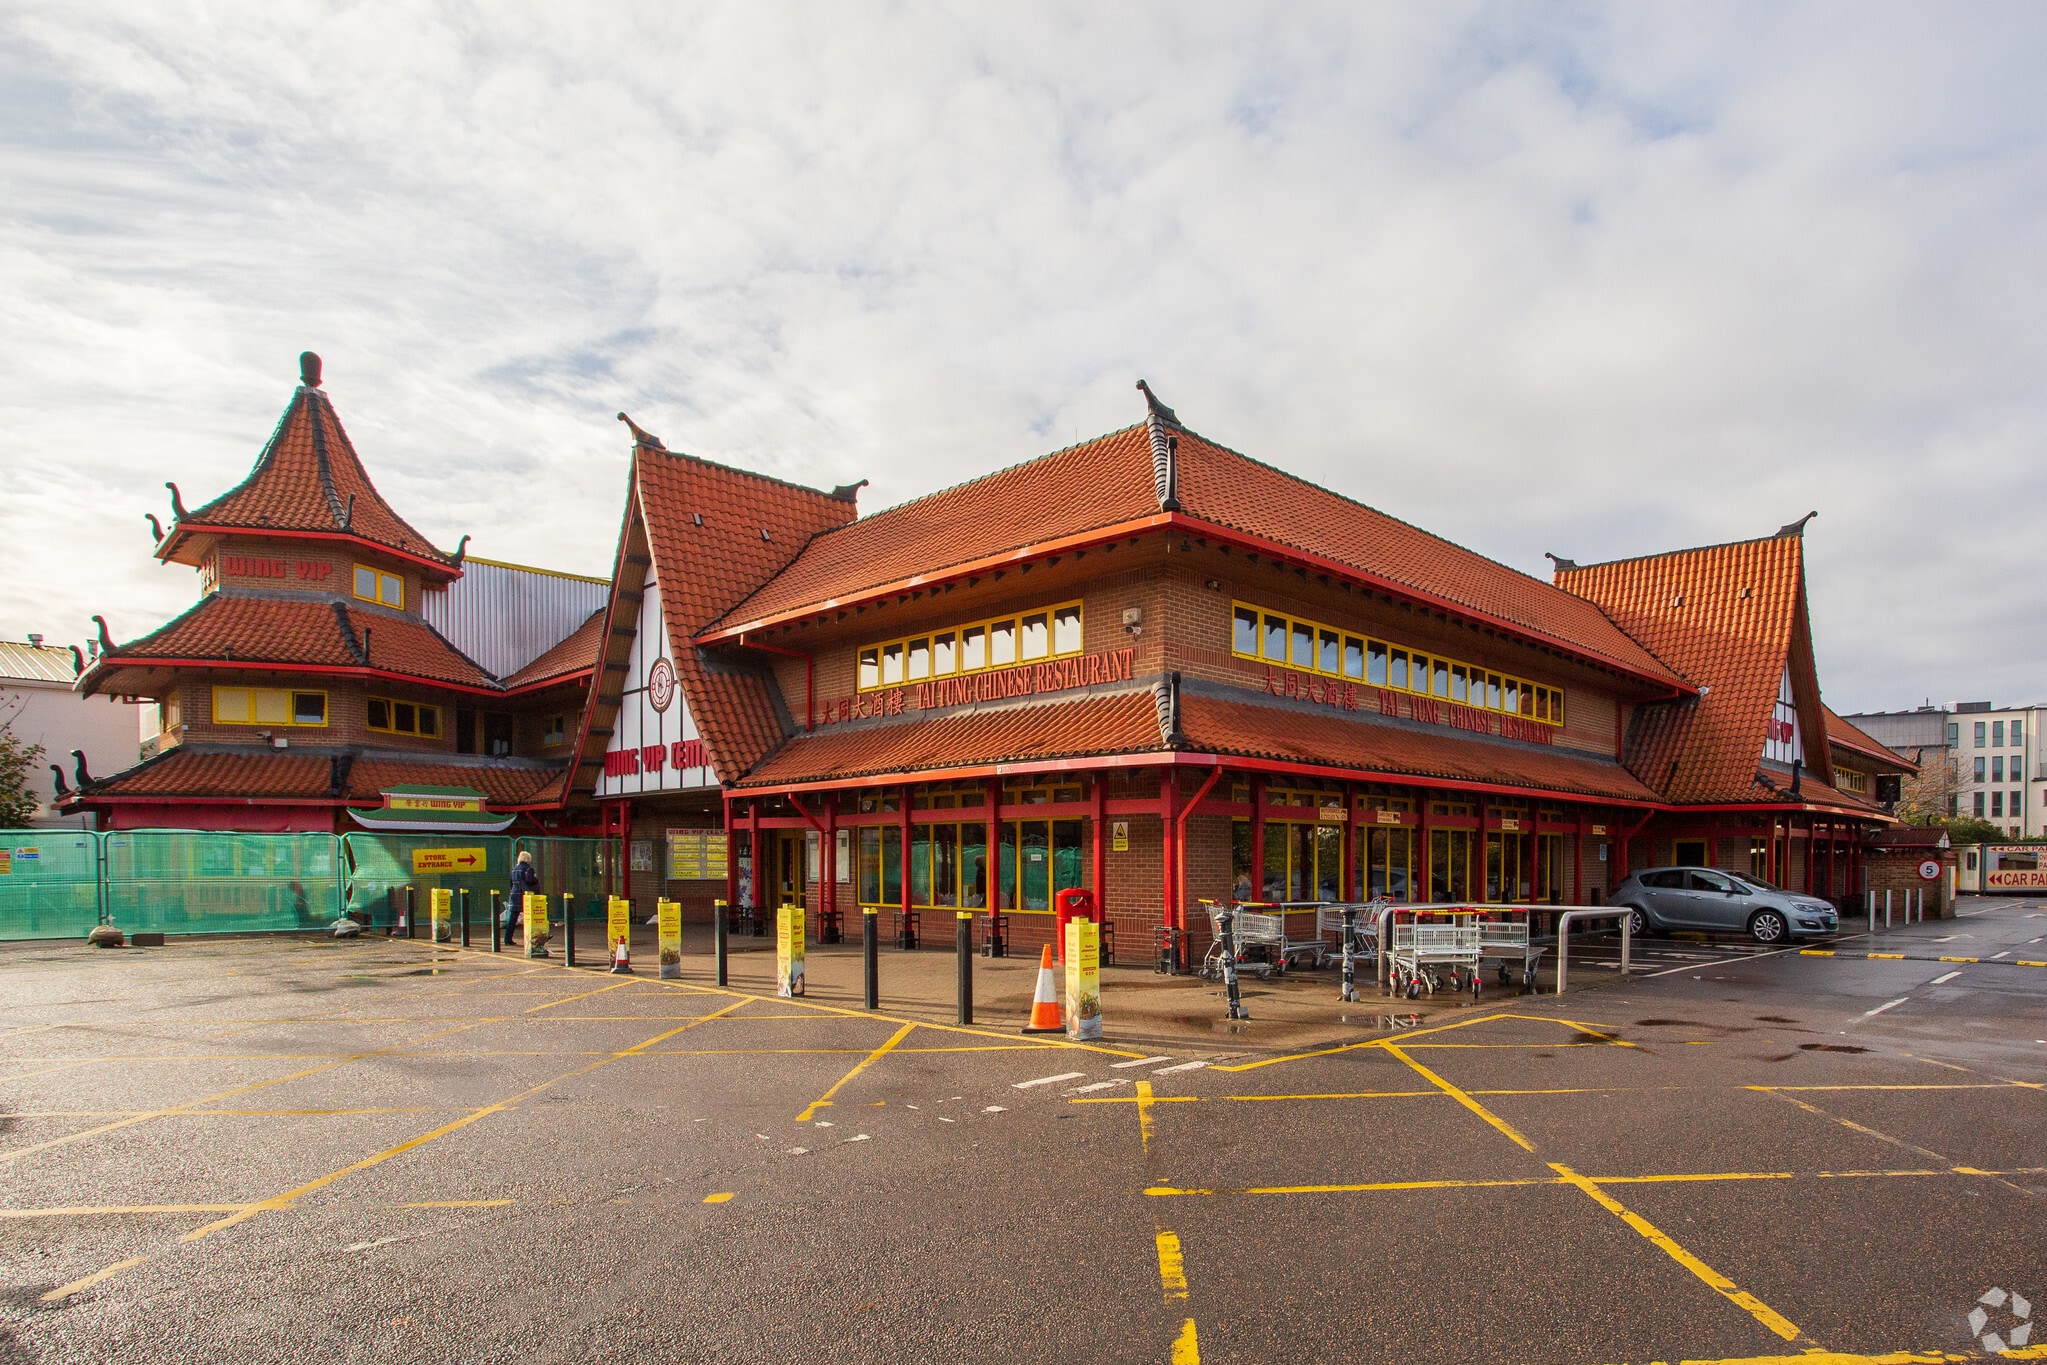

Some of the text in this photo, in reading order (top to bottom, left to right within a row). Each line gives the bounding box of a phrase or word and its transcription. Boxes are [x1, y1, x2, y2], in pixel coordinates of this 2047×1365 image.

[224, 556, 286, 578] WING
[295, 560, 333, 580] YIP
[916, 648, 1134, 710] TAI TUNG CHINESE RESTAURANT
[1264, 665, 1359, 712] 大同大酒樓
[822, 687, 906, 725] 大同大酒樓
[1380, 689, 1554, 745] TAI TUNG CHINESE RESTAURANT
[605, 748, 639, 777] WING
[642, 744, 666, 773] YIP
[430, 800, 451, 808] WING
[1925, 865, 1934, 874] 5
[2004, 873, 2028, 885] CAR
